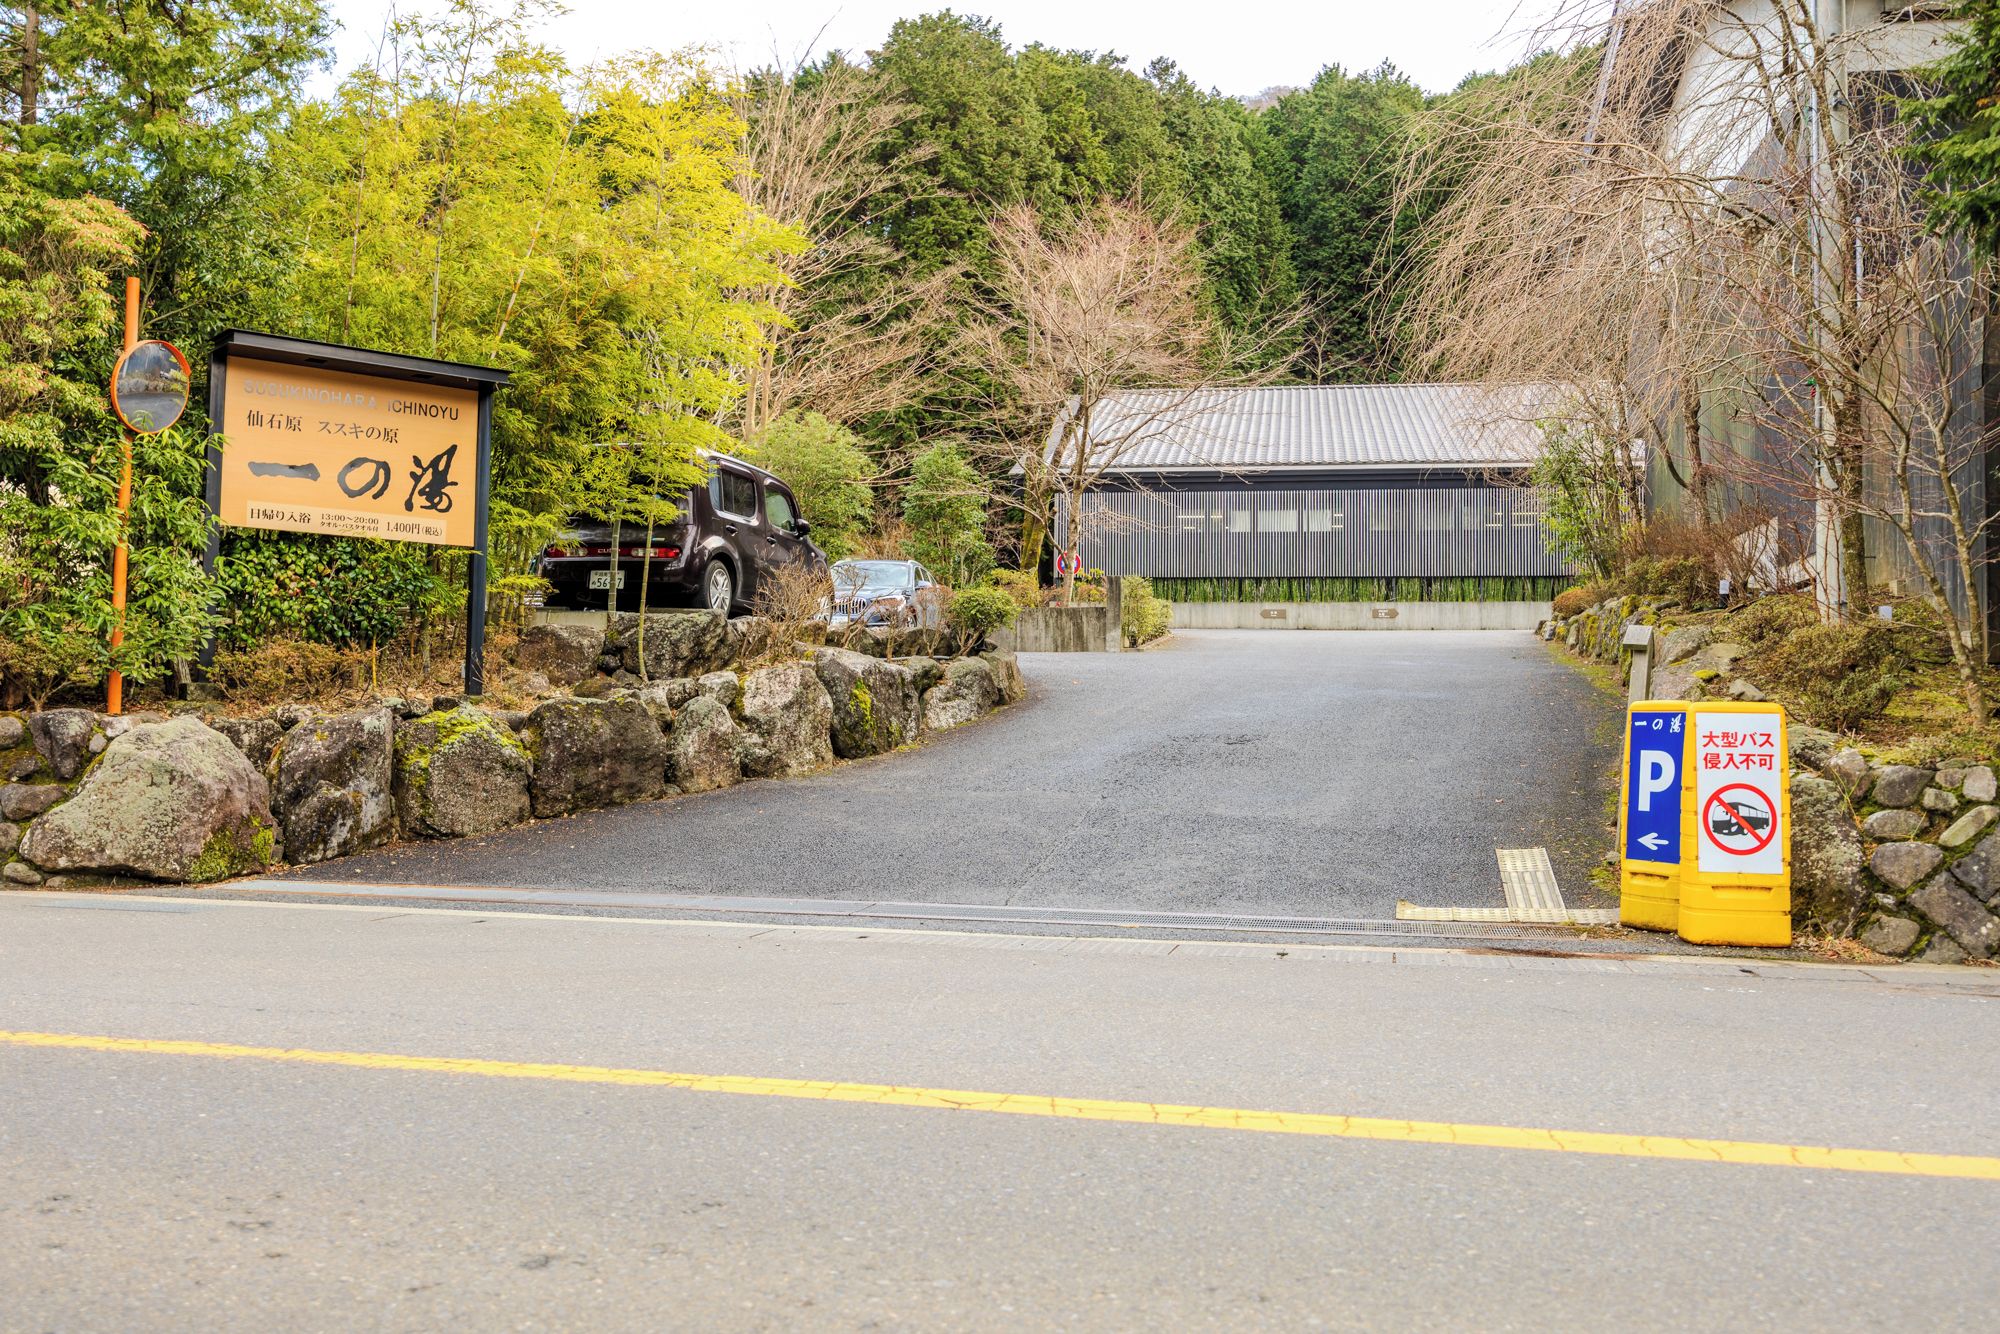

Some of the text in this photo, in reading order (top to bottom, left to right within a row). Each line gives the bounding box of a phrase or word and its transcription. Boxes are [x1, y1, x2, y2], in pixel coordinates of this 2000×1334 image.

[243, 379, 459, 421] SUSUKINOHARA ICHINOYU
[247, 409, 400, 444] 仙石原 ススキの原
[247, 443, 459, 513] 一の湯
[250, 507, 311, 524] 日帰り入浴
[1634, 713, 1681, 734] 一の湯
[1702, 731, 1775, 749] 大型バス
[1702, 753, 1775, 771] 侵入不可
[1637, 749, 1676, 812] P
